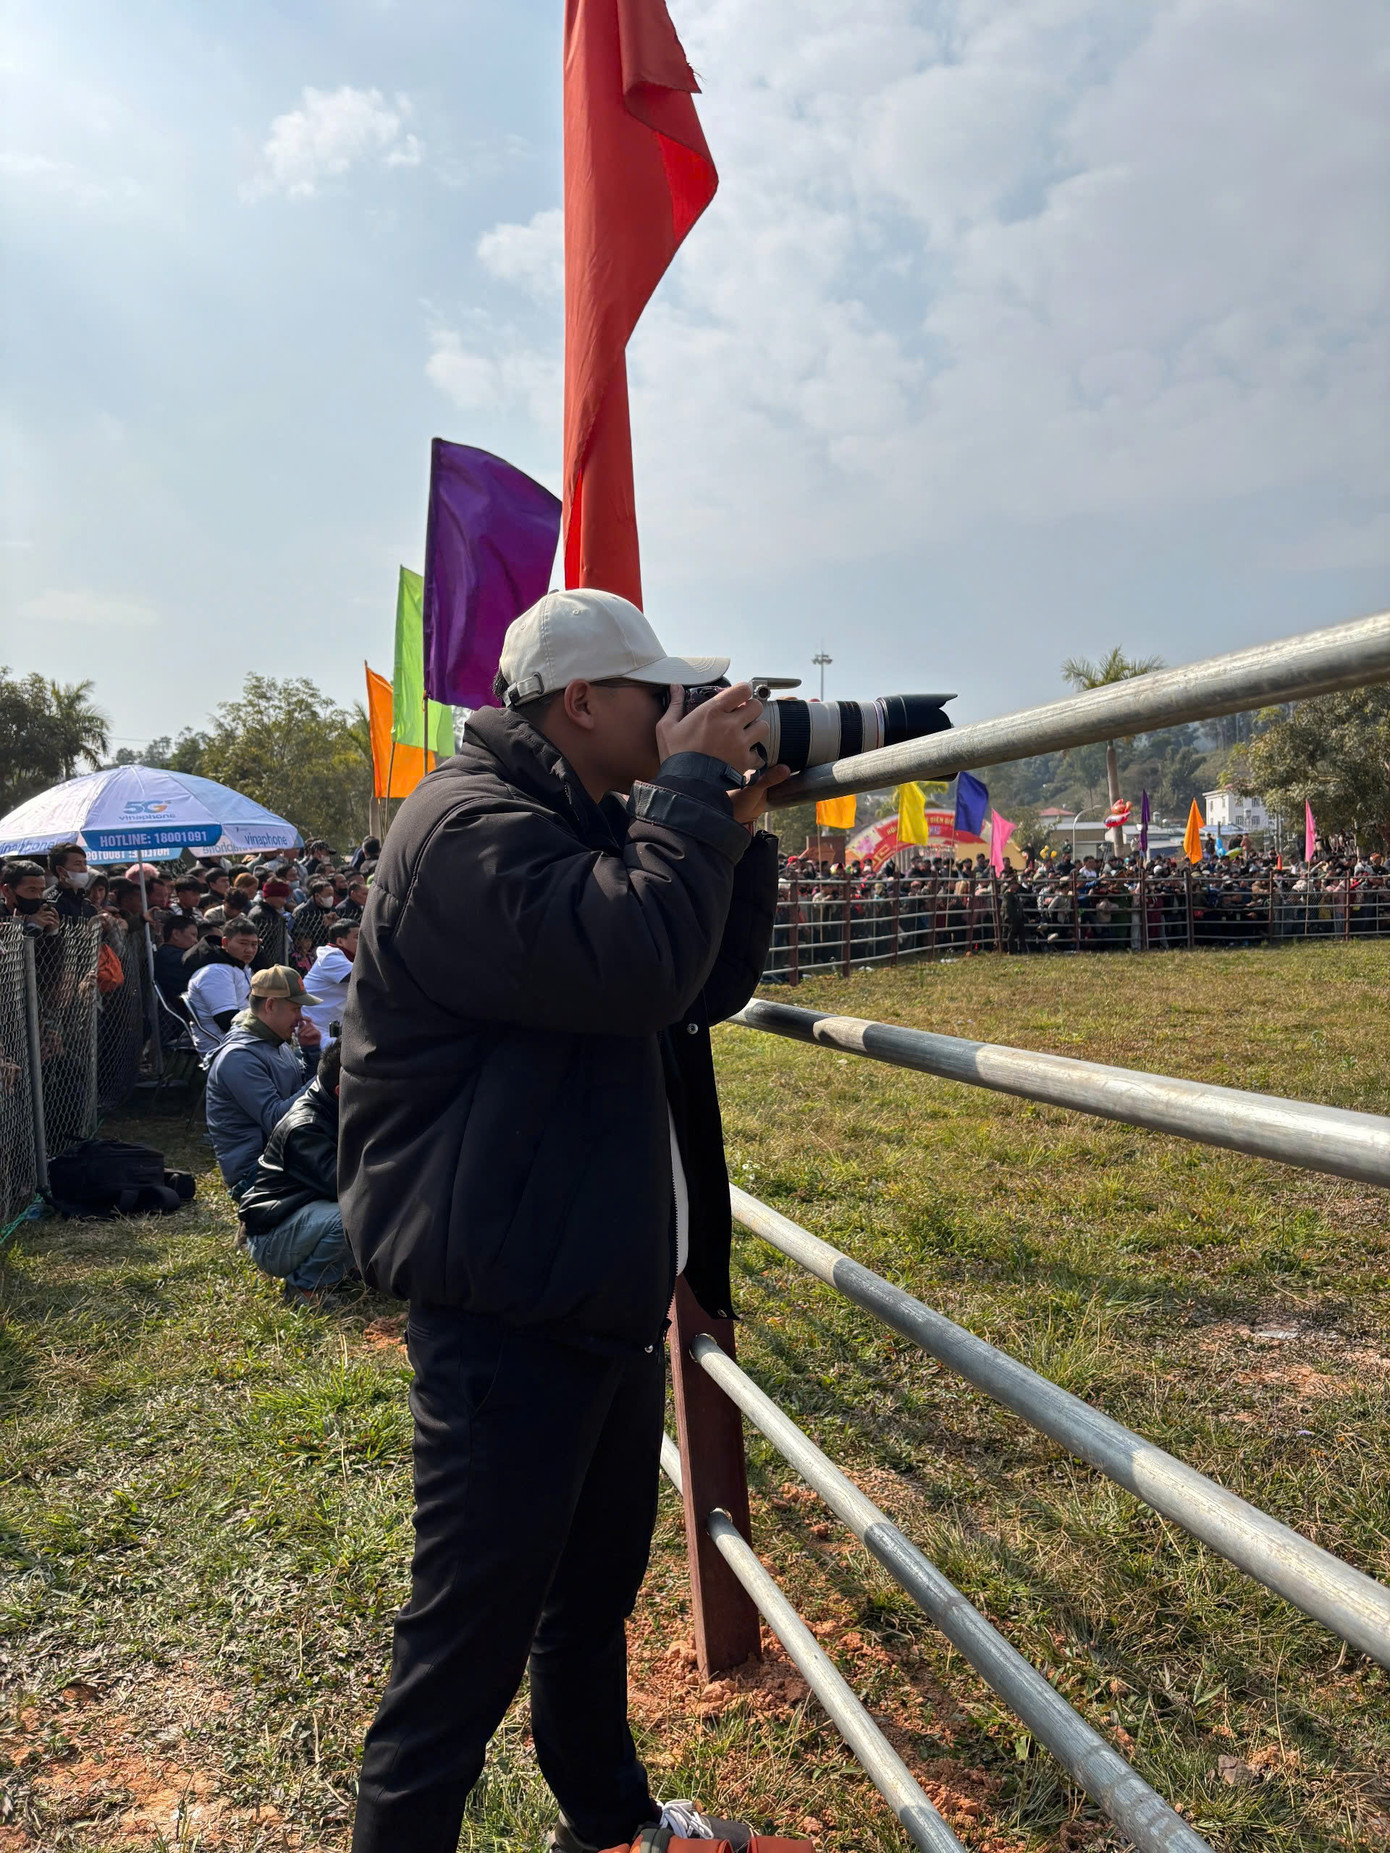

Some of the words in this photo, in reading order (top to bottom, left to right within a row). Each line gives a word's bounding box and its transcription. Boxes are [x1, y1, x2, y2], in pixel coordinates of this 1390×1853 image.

[123, 800, 168, 814] 5G
[118, 813, 176, 821] vinaphone
[101, 834, 152, 847] HOTLINE:
[154, 831, 207, 844] 18001091
[244, 832, 288, 847] vinaphone
[0, 841, 54, 854] inaphone
